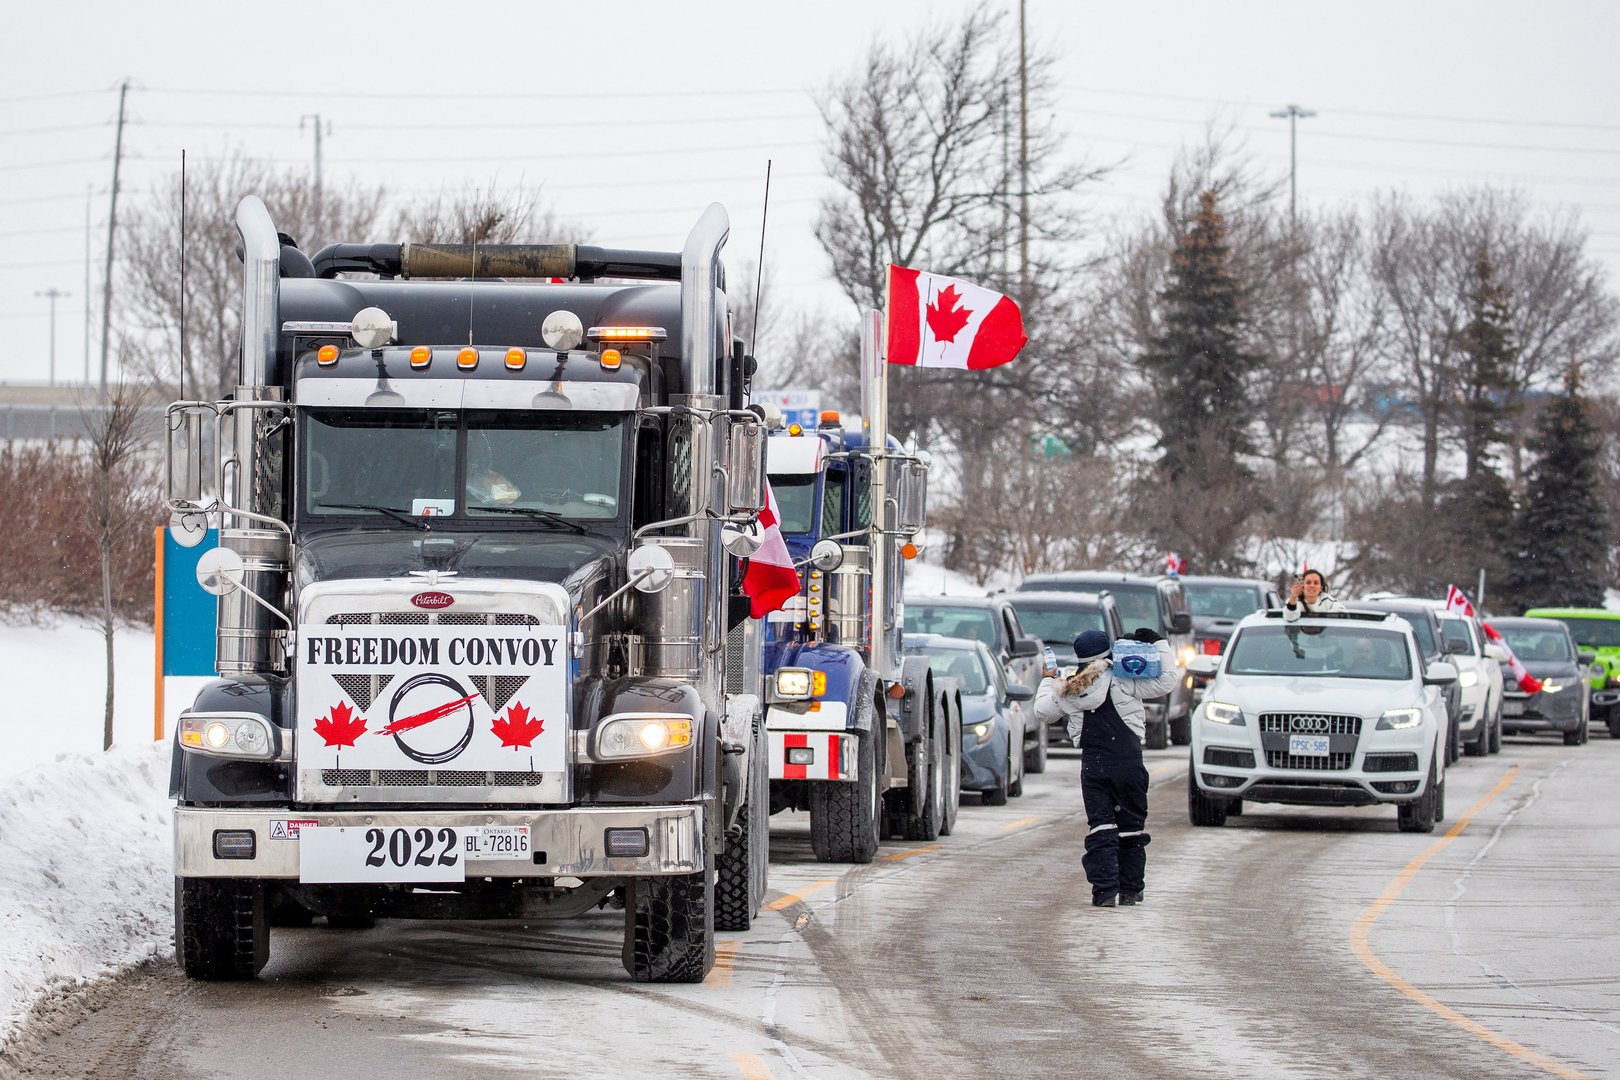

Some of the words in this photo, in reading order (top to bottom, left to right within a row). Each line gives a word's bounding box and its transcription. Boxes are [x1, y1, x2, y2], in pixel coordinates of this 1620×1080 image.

[415, 594, 451, 605] Peterbilt
[306, 637, 440, 666] FREEDOM
[449, 637, 558, 666] CONVOY
[365, 828, 458, 868] 2022
[489, 835, 528, 852] 72816
